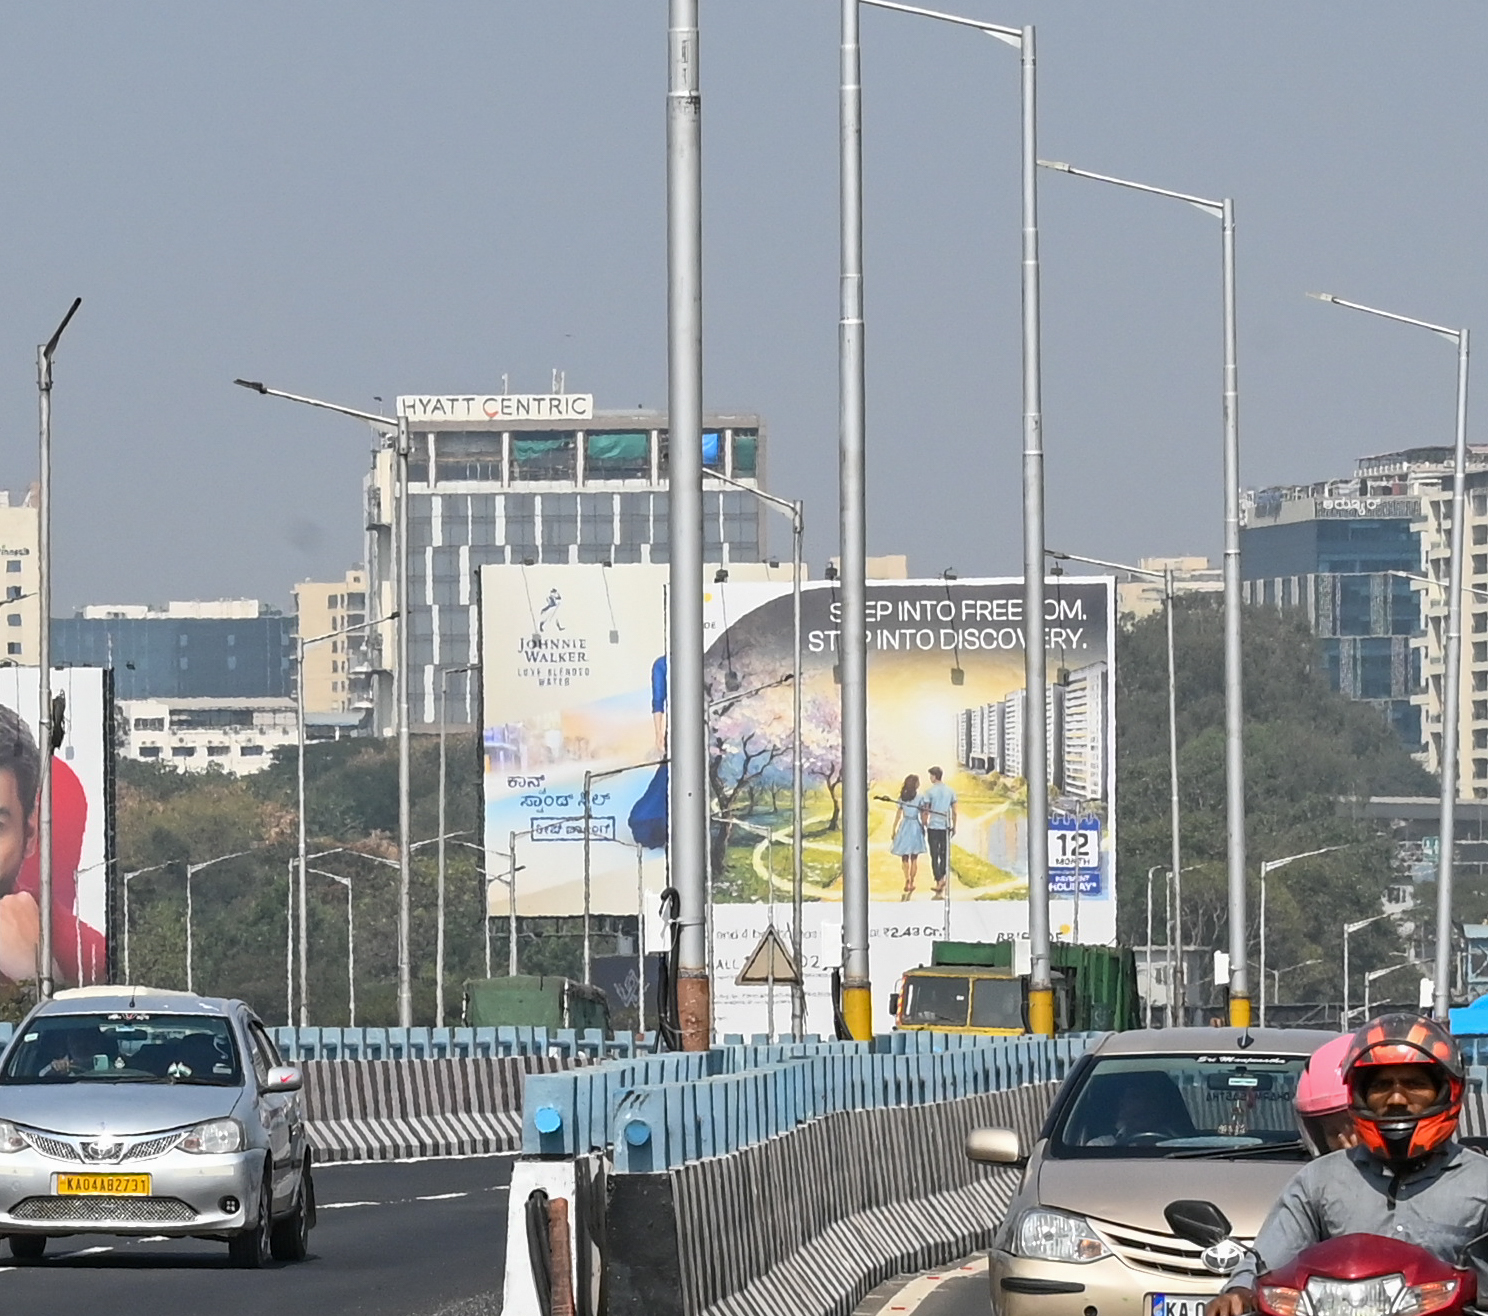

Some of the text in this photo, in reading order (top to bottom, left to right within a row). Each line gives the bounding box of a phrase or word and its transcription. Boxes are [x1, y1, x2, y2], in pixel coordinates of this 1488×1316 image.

[403, 397, 587, 418] HYATT CENTRIC
[830, 599, 1087, 623] SEP INTO FREEOM.
[518, 638, 587, 653] JOHNNIE
[876, 630, 935, 651] INTO
[524, 651, 588, 663] WALKER
[1056, 833, 1090, 856] 12
[1055, 858, 1090, 866] MONTH
[1049, 882, 1097, 892] HOLIAY
[67, 1178, 146, 1192] KA04AB2731
